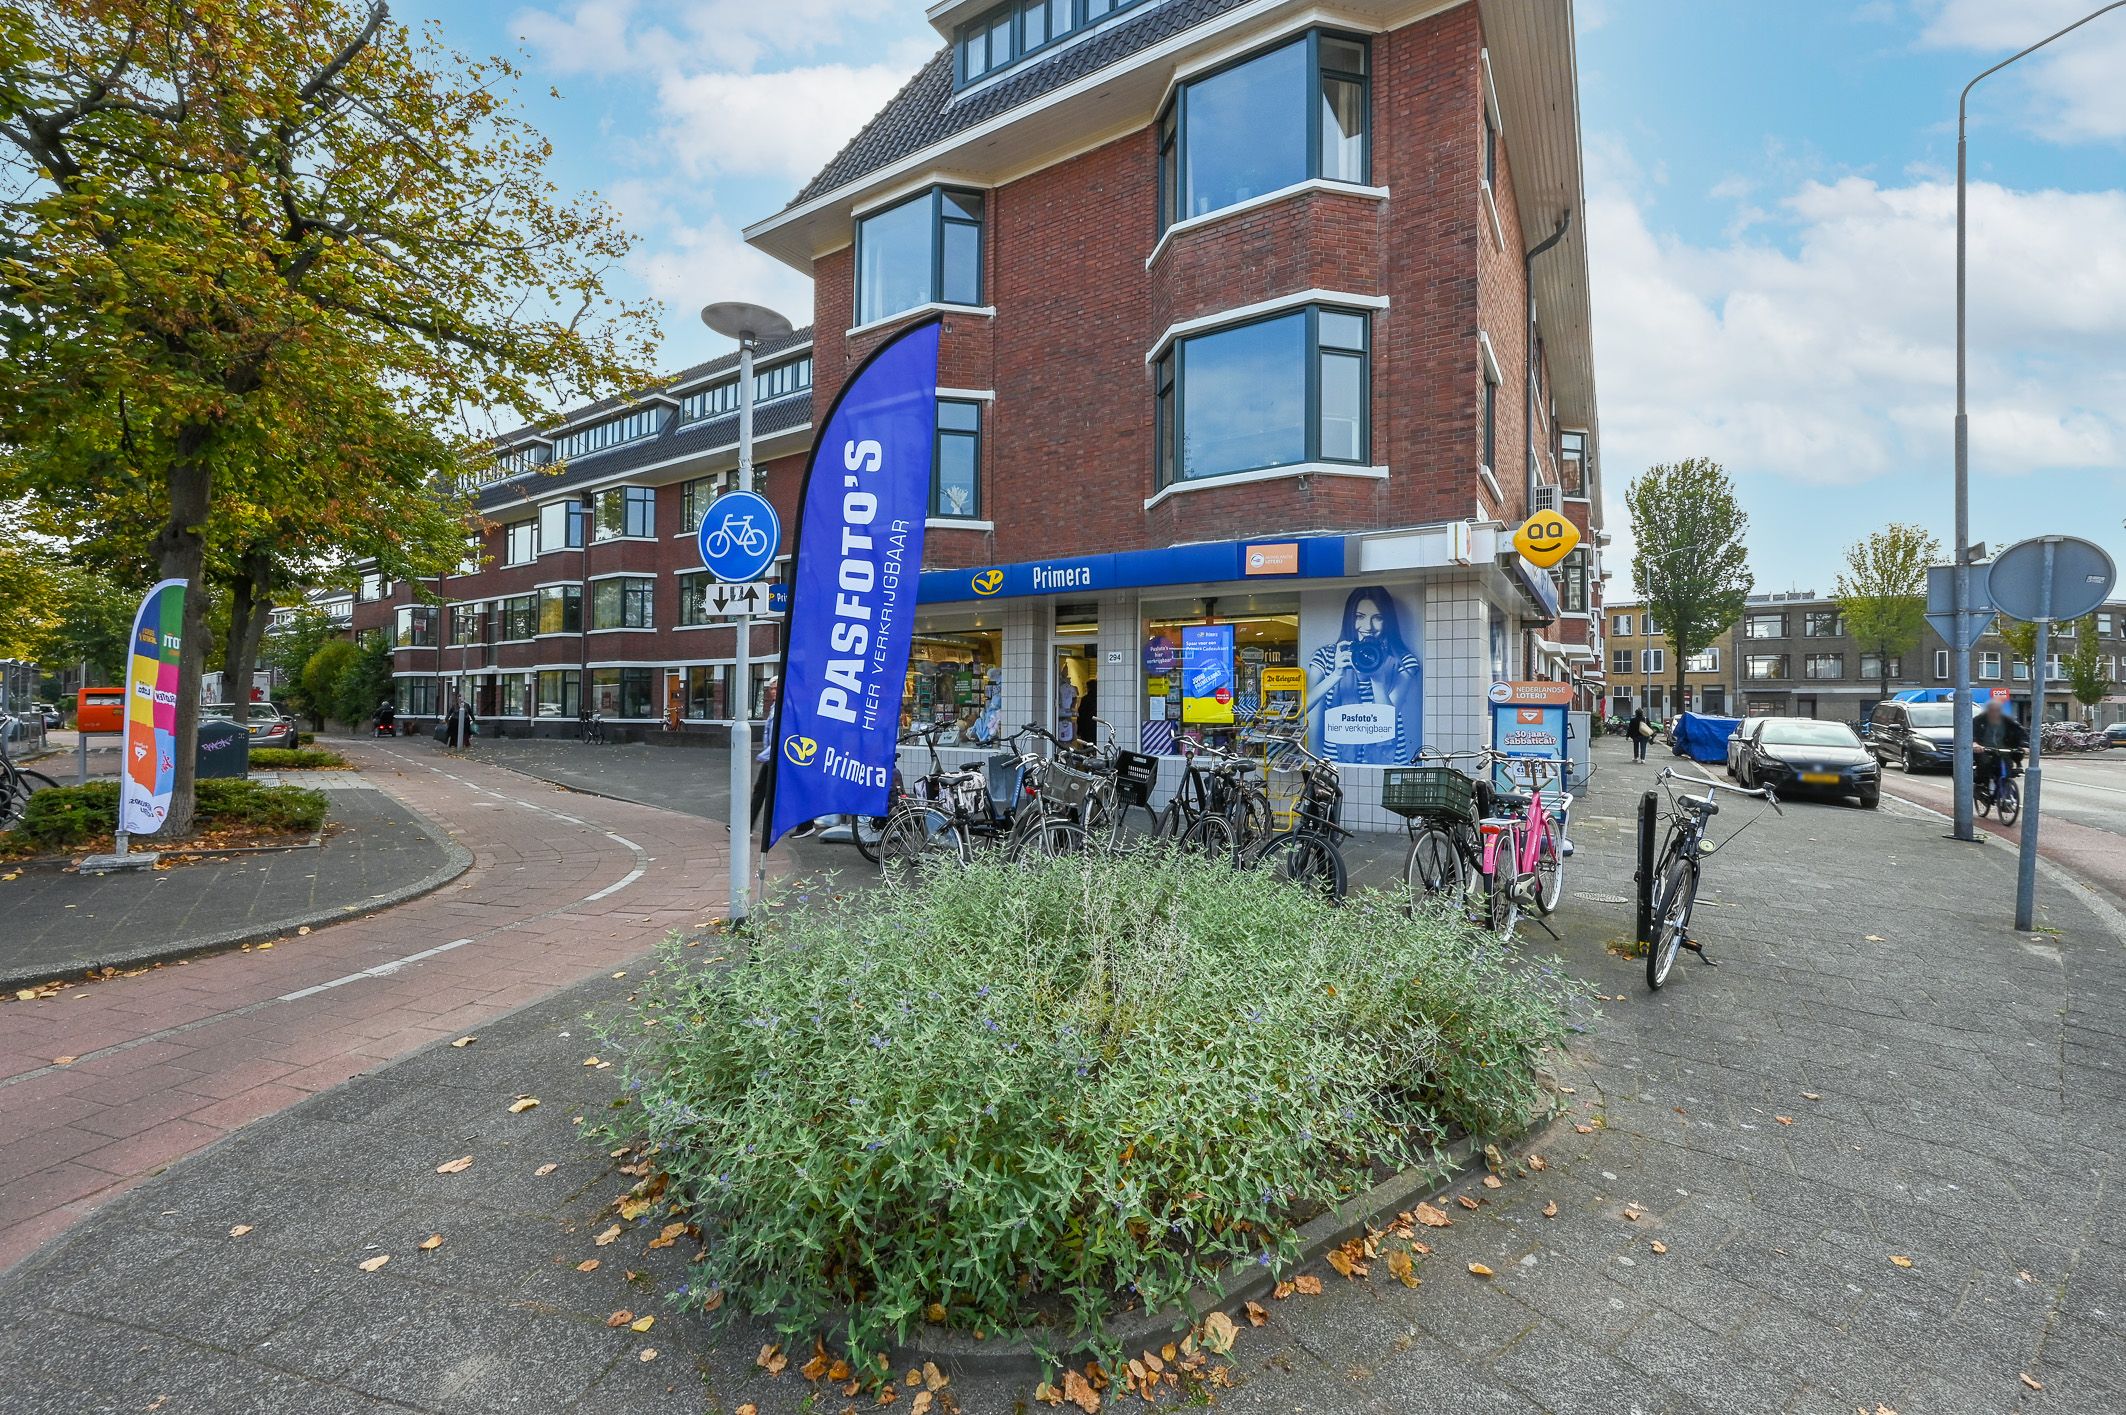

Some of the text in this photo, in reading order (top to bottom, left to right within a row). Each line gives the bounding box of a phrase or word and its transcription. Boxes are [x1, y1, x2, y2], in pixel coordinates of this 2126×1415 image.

[817, 440, 882, 723] PASFOTO'S
[1033, 566, 1090, 589] Primera
[862, 519, 910, 731] HIER VERKRIJGBAAR
[1109, 653, 1121, 661] 294
[1275, 675, 1302, 683] Telegraaf
[1341, 713, 1378, 723] Pasfoto's
[1327, 723, 1393, 735] hier verkrijgbaar
[1504, 736, 1557, 745] Sabbatical?
[823, 746, 887, 788] Primera
